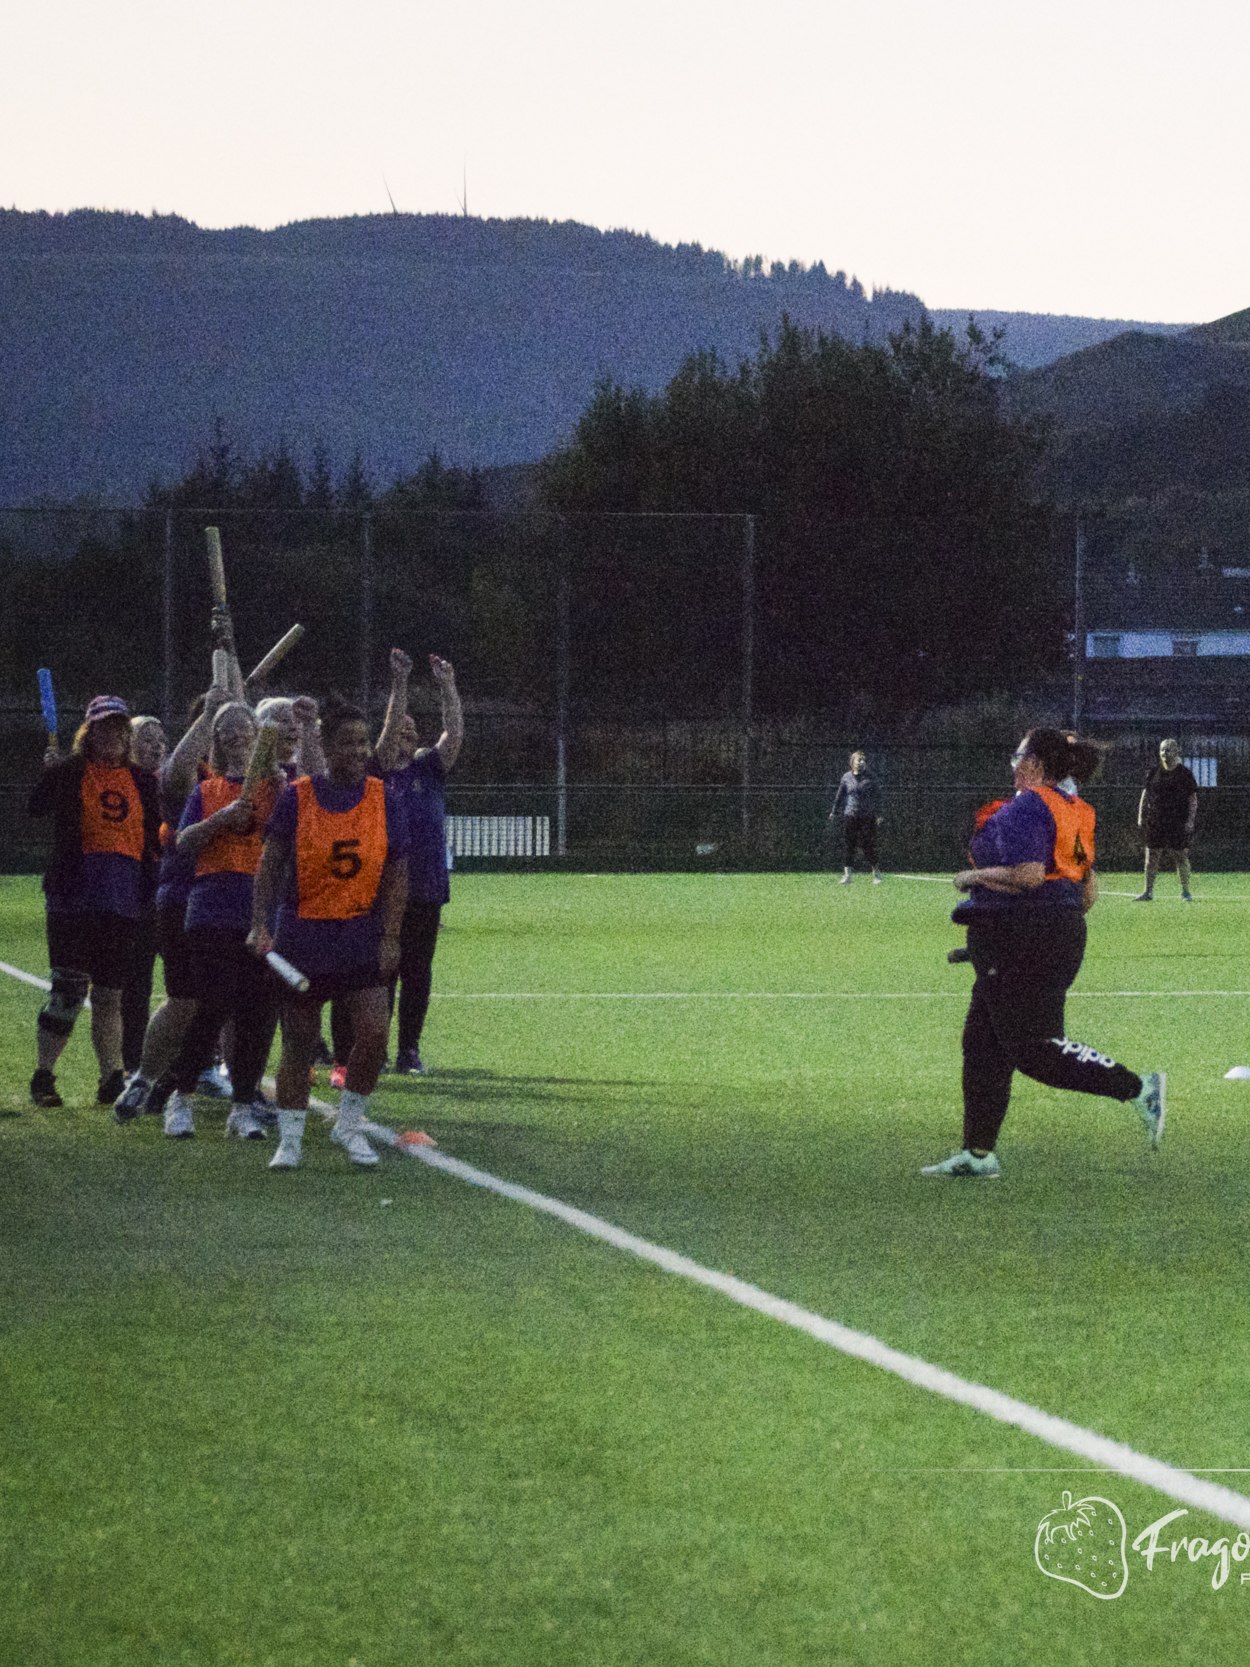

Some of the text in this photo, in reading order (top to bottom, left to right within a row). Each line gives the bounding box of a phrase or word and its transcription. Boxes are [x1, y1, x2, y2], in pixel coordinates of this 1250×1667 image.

[100, 790, 129, 823] 9
[331, 839, 362, 880] 5
[1071, 831, 1088, 866] 4
[1051, 1036, 1115, 1068] adid
